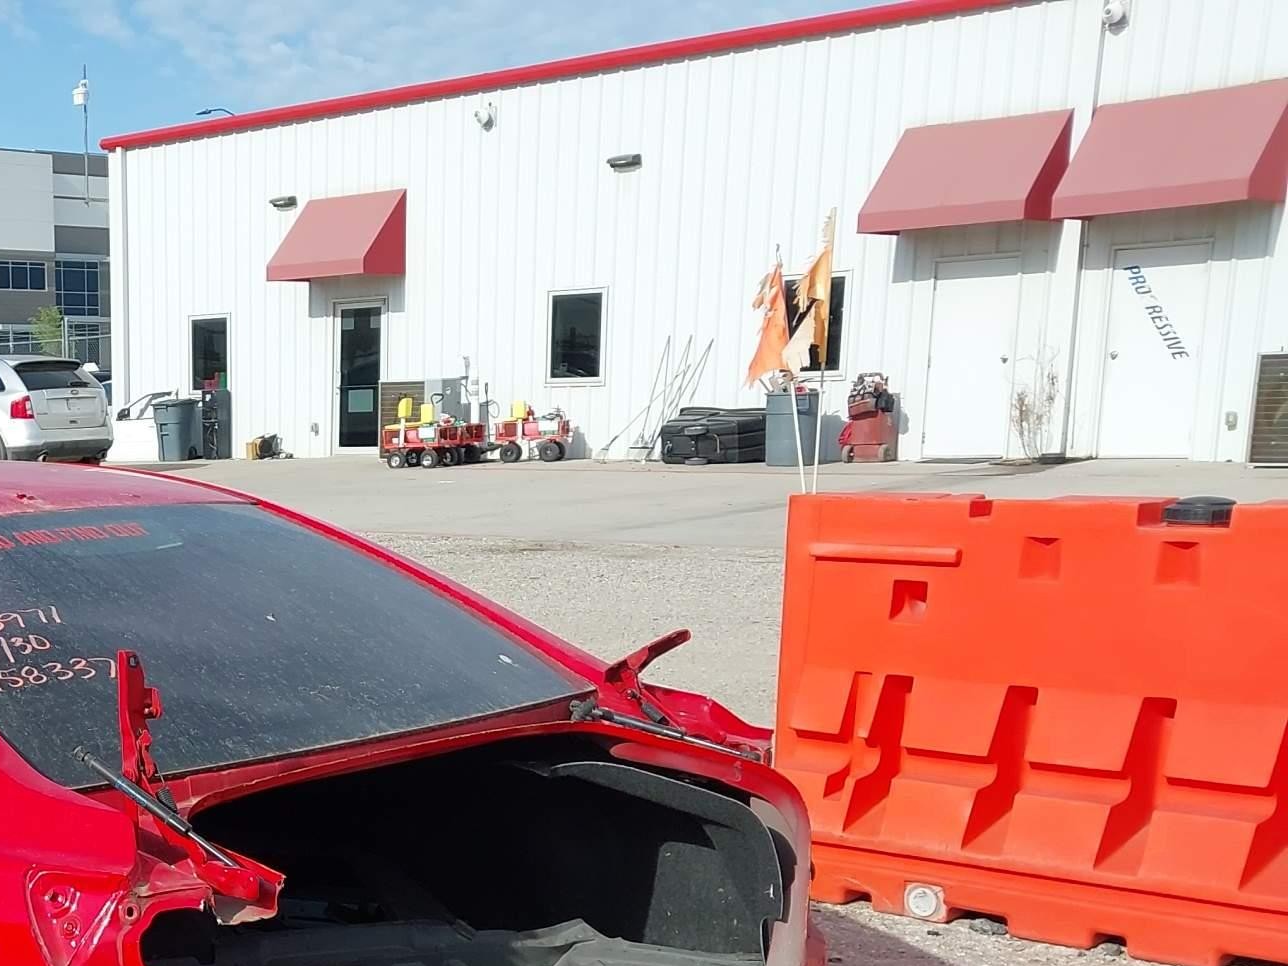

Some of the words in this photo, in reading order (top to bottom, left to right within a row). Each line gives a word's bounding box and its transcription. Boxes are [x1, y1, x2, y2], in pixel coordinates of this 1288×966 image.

[1123, 265, 1190, 360] PRORESSIVE
[12, 529, 61, 546] AND
[55, 525, 110, 541] FIND
[104, 522, 150, 536] OUT
